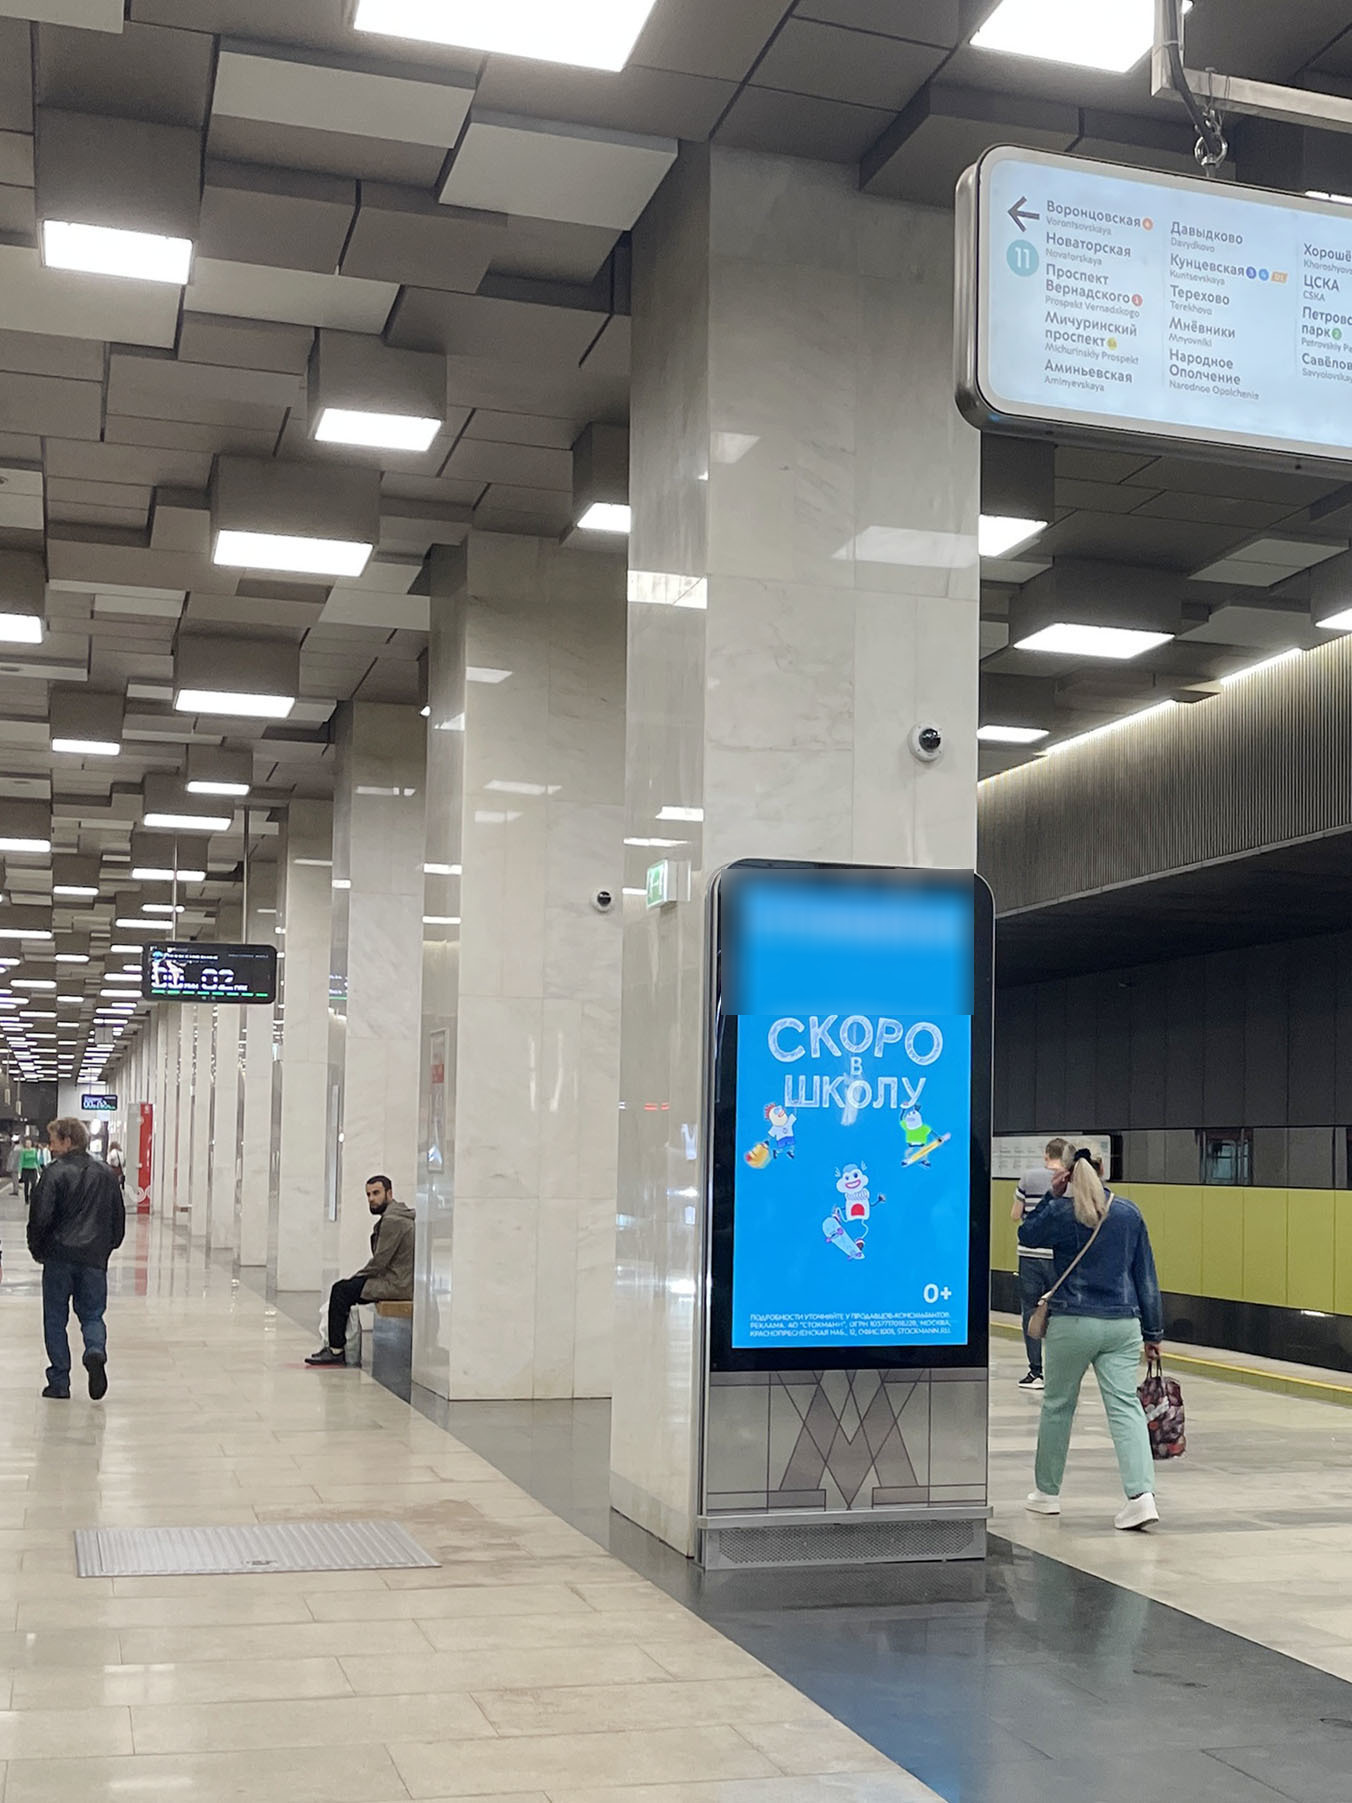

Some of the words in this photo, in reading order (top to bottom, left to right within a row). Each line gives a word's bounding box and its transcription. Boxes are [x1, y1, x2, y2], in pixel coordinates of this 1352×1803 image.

[1047, 200, 1141, 227] Воронцовская
[1046, 216, 1112, 236] Vorontsovskaya
[1170, 221, 1243, 245] Давыдково
[1046, 231, 1131, 257] Новаторская
[1015, 248, 1030, 269] 11
[1046, 248, 1103, 267] Novatorskaya
[1170, 253, 1245, 277] Кунцевская
[1046, 263, 1109, 286] Проспект
[1169, 269, 1226, 286] Kuntsevskaya
[1303, 274, 1340, 292] ЦСКА
[1046, 279, 1130, 304] Вернадского
[1170, 284, 1230, 305] Терехово
[1303, 290, 1326, 302] CSKA
[1045, 295, 1083, 310] Prospekt
[1086, 302, 1140, 319] Vernadskogo
[1045, 311, 1137, 337] Мичуринский
[1169, 317, 1236, 338] Мнёвники
[1301, 324, 1331, 341] парк
[1045, 329, 1106, 348] проспект
[1101, 350, 1139, 365] Prospekt
[1169, 348, 1234, 370] Народное
[1044, 359, 1132, 383] Аминьевская
[1169, 364, 1241, 385] Ополчение
[768, 1015, 943, 1066] СКОРО
[850, 1056, 863, 1075] В
[784, 1074, 927, 1109] ШКОЛУ
[923, 1283, 952, 1304] 0+
[750, 1313, 803, 1321] ПОДРОБНОСТИ
[788, 1321, 798, 1329] АО
[750, 1329, 828, 1337] КРАСНОПРЕСНЕНСКАЯ
